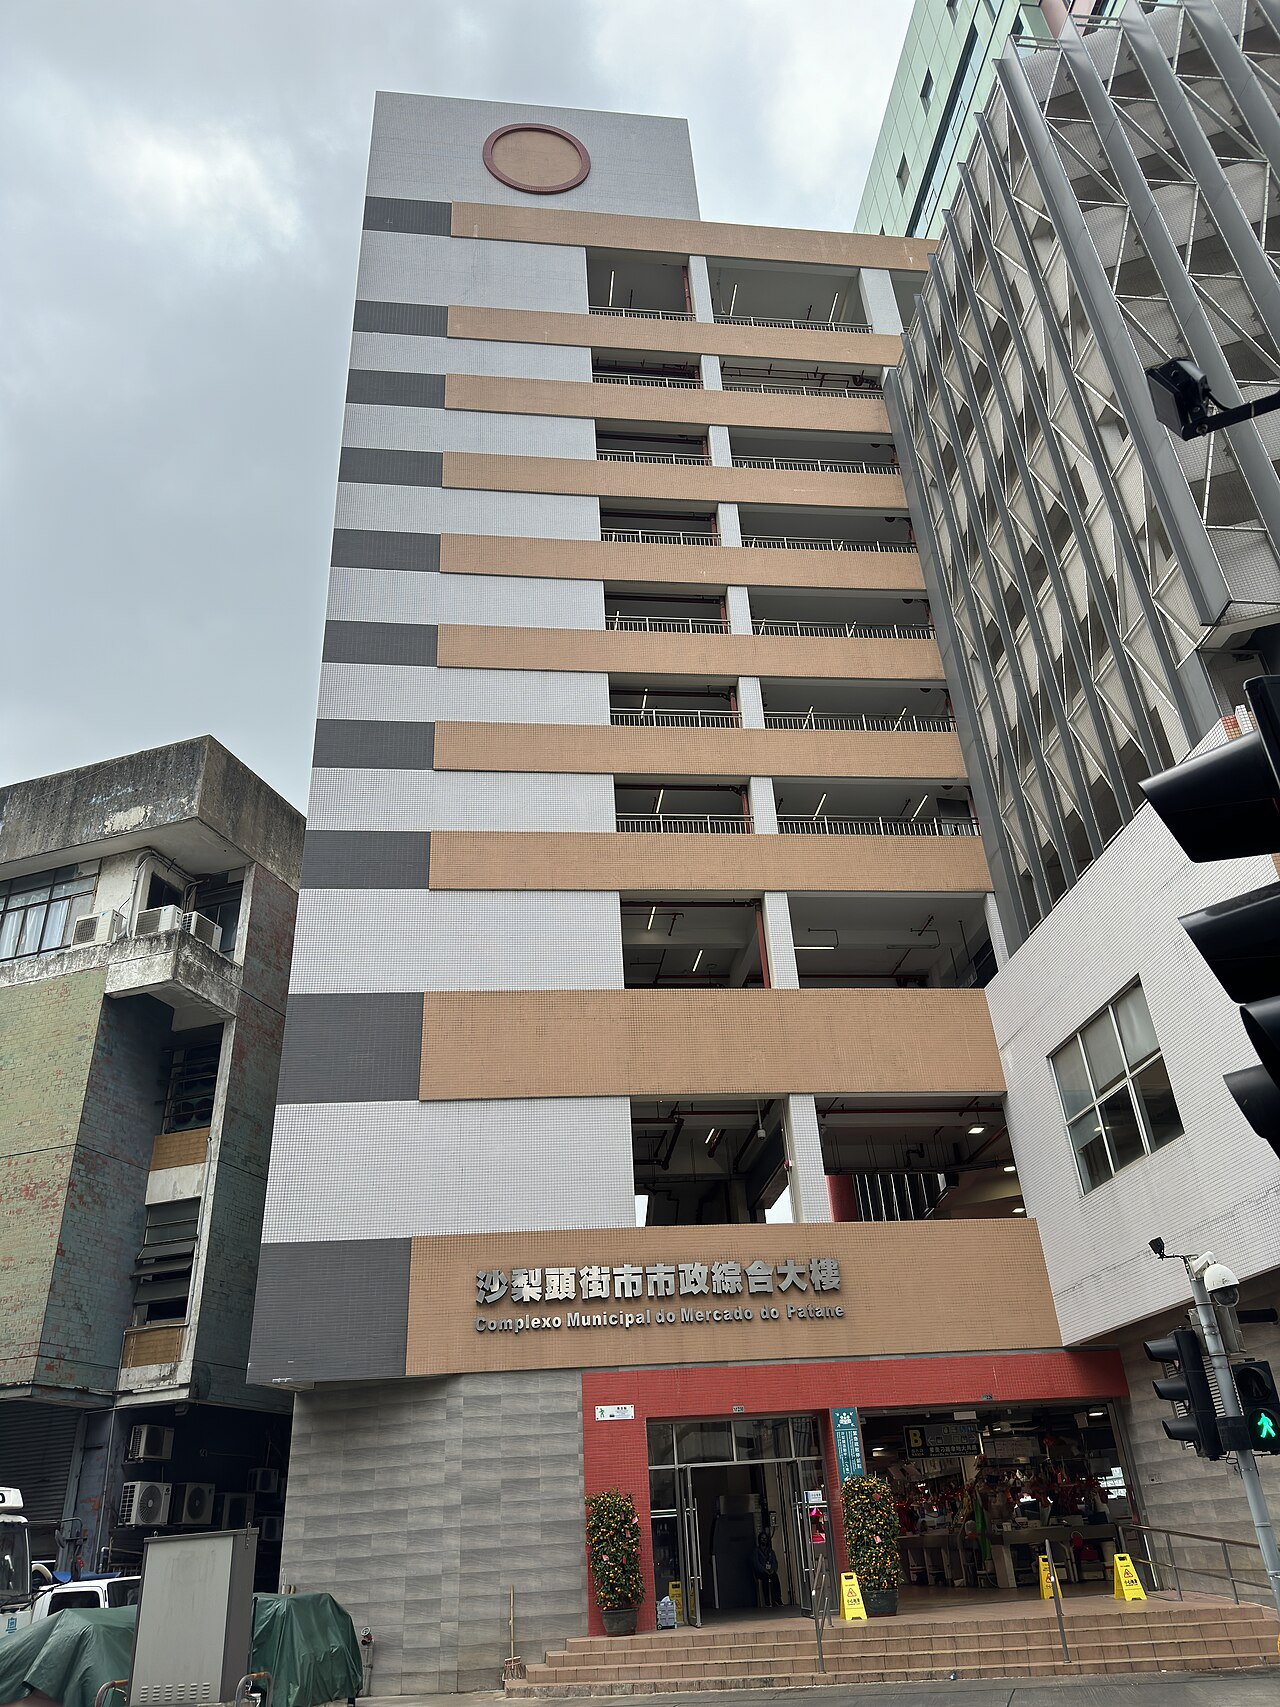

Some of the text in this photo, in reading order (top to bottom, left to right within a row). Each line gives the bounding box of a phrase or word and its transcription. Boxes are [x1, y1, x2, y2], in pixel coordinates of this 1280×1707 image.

[476, 1258, 840, 1304] 沙梨頭街市市政綜合大樓
[475, 1303, 845, 1334] Complexo Municipal do Mercado do Patane
[909, 1430, 922, 1447] B
